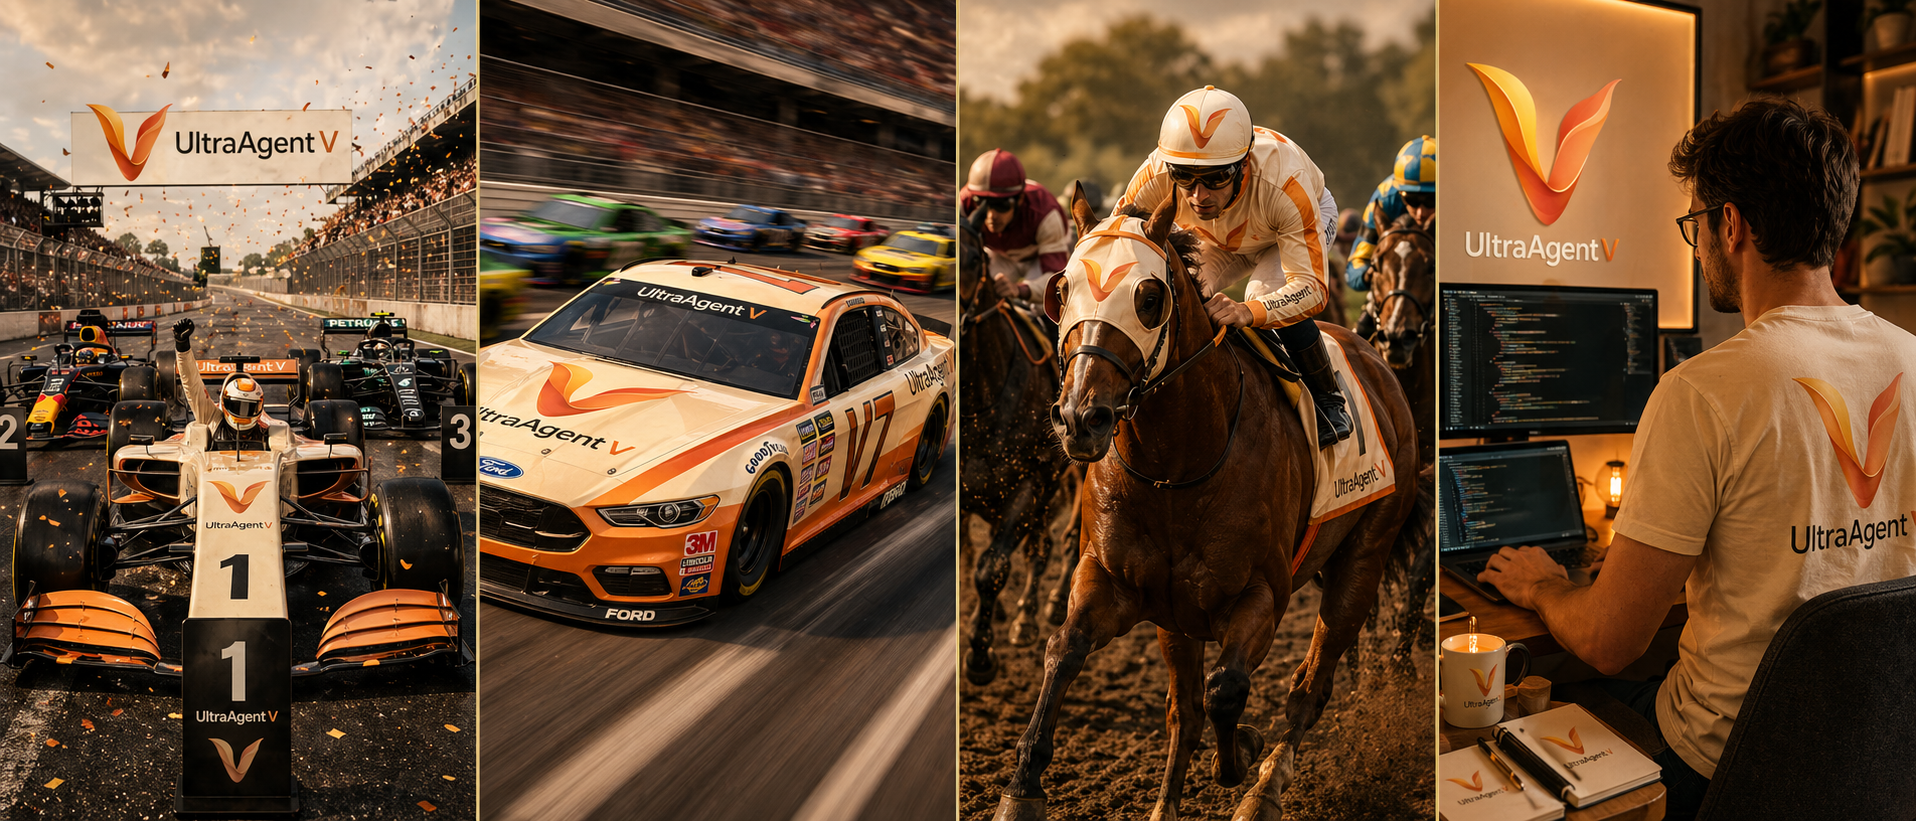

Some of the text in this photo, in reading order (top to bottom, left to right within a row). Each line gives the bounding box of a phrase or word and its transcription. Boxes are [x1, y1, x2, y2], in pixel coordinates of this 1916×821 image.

[175, 130, 339, 159] UltraAgent V
[1465, 231, 1620, 267] UltraAgent V
[637, 286, 767, 320] UltraAgent V
[275, 361, 286, 371] V
[0, 414, 19, 449] 2
[450, 413, 471, 450] 3
[480, 406, 636, 456] ltraAgent V
[839, 390, 895, 503] V7
[1334, 459, 1386, 499] UltraAgent V
[205, 521, 273, 530] UltraAgent V
[1791, 513, 1908, 554] UltraAgent
[686, 531, 717, 556] 3M
[220, 554, 249, 600] 1
[605, 608, 656, 621] FORD
[221, 641, 246, 702] 1
[196, 710, 279, 726] UltraAgent V
